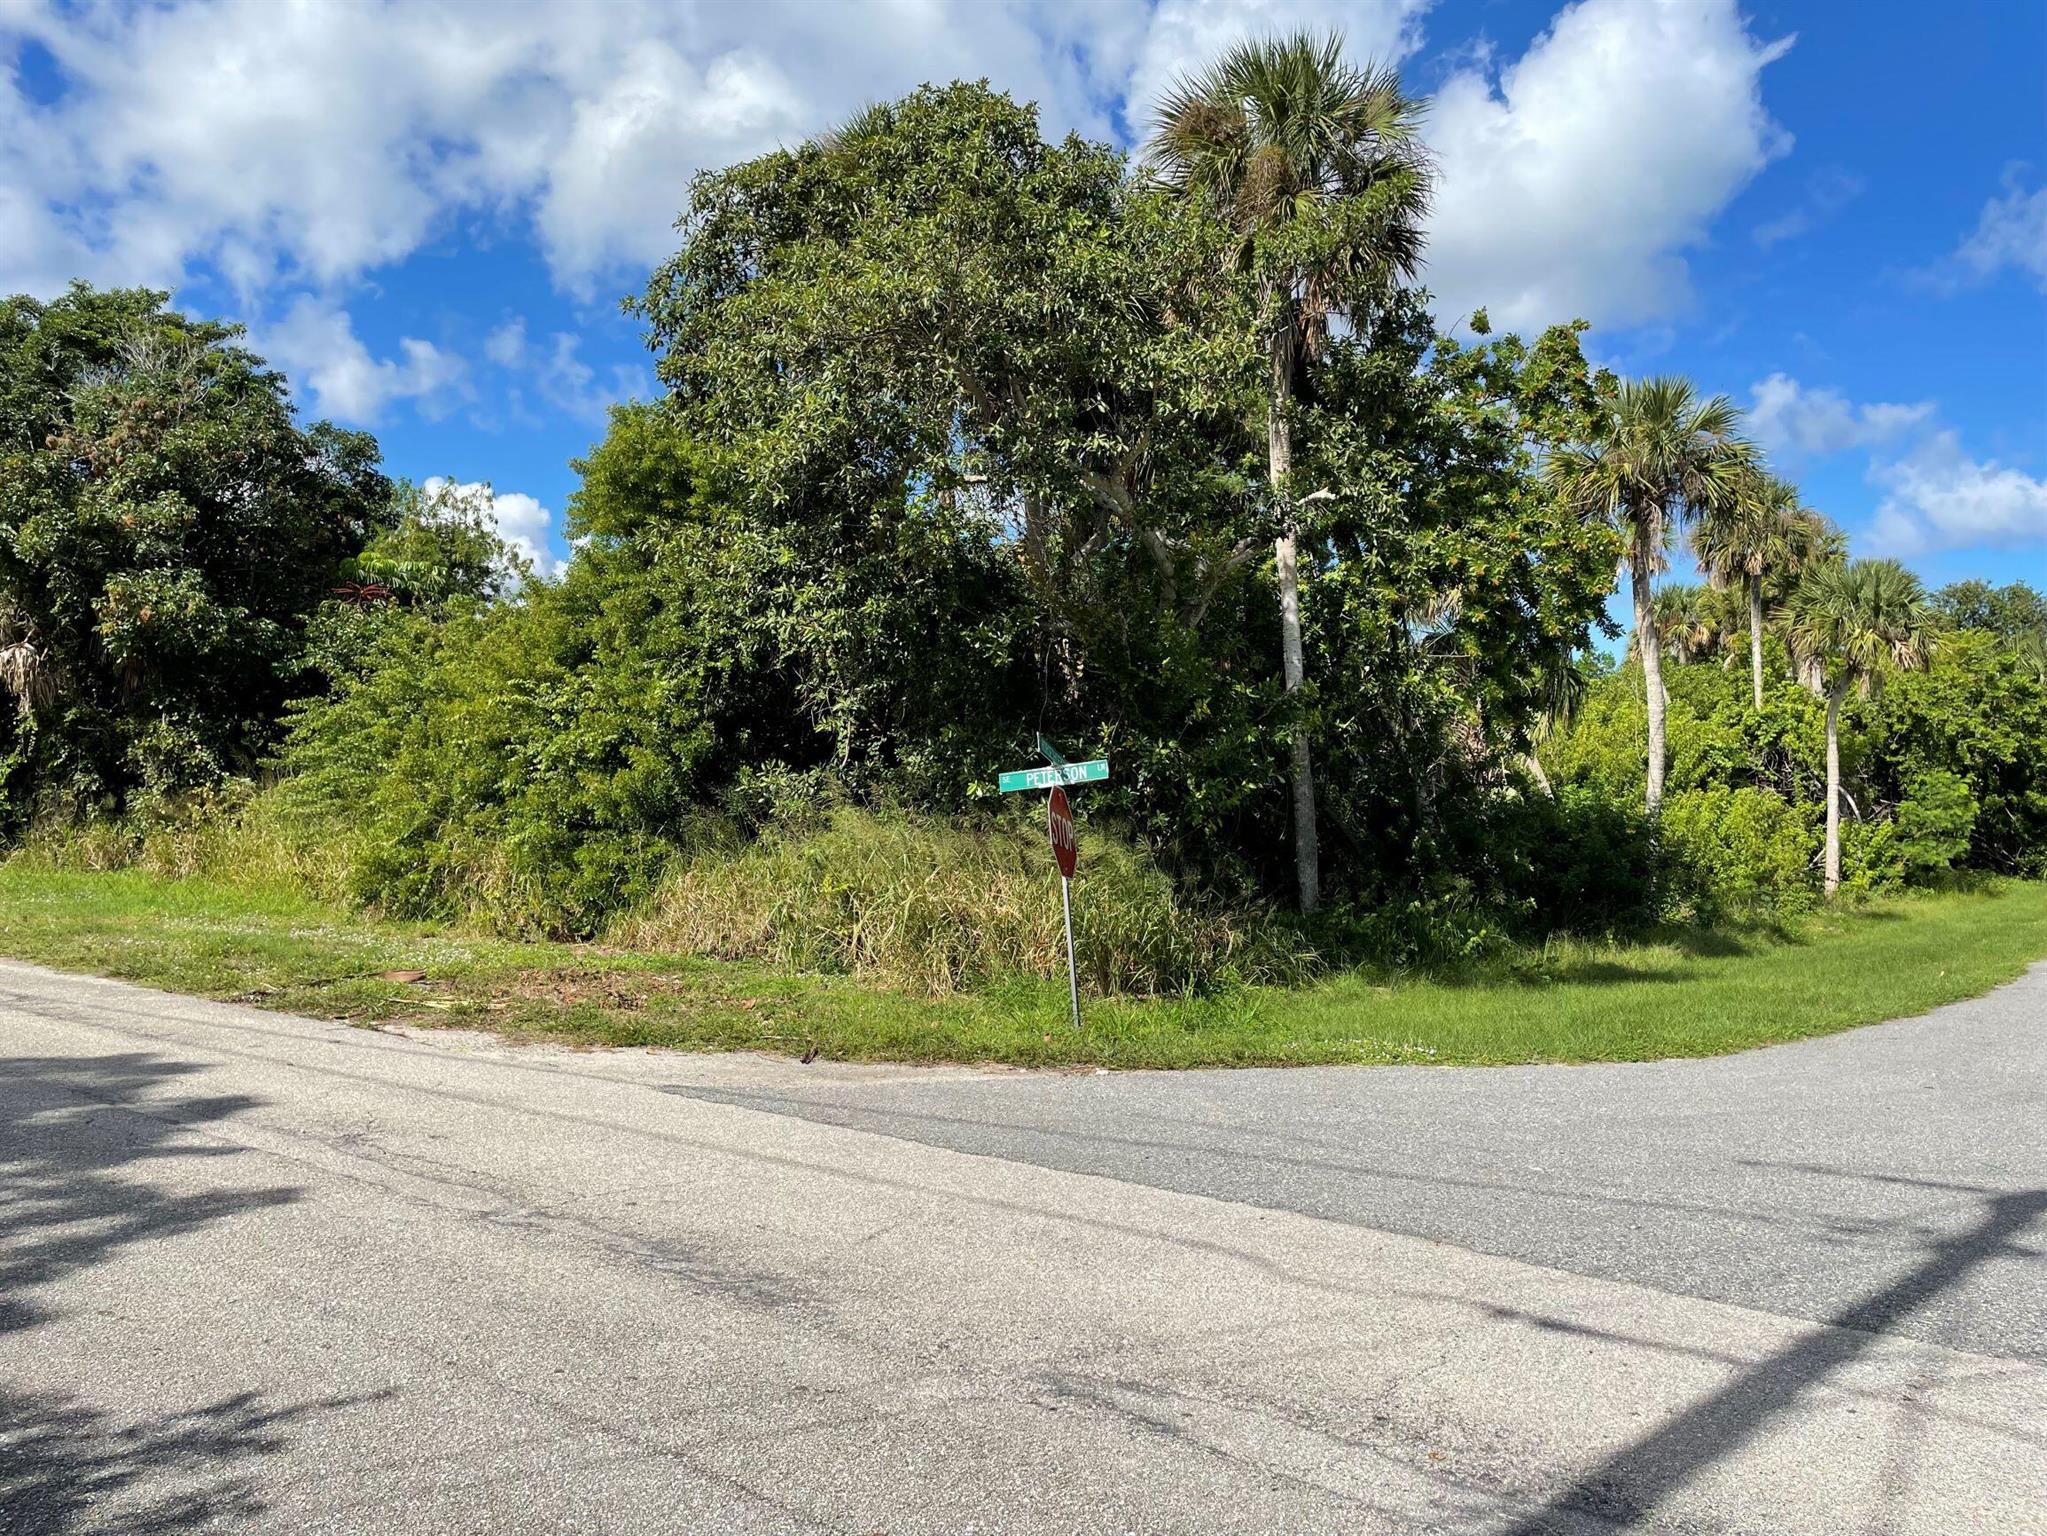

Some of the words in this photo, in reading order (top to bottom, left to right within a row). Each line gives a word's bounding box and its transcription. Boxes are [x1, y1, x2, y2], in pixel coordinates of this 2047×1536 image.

[1002, 775, 1011, 784] SE
[1026, 765, 1088, 787] PETERSON
[1051, 811, 1073, 851] STOP
